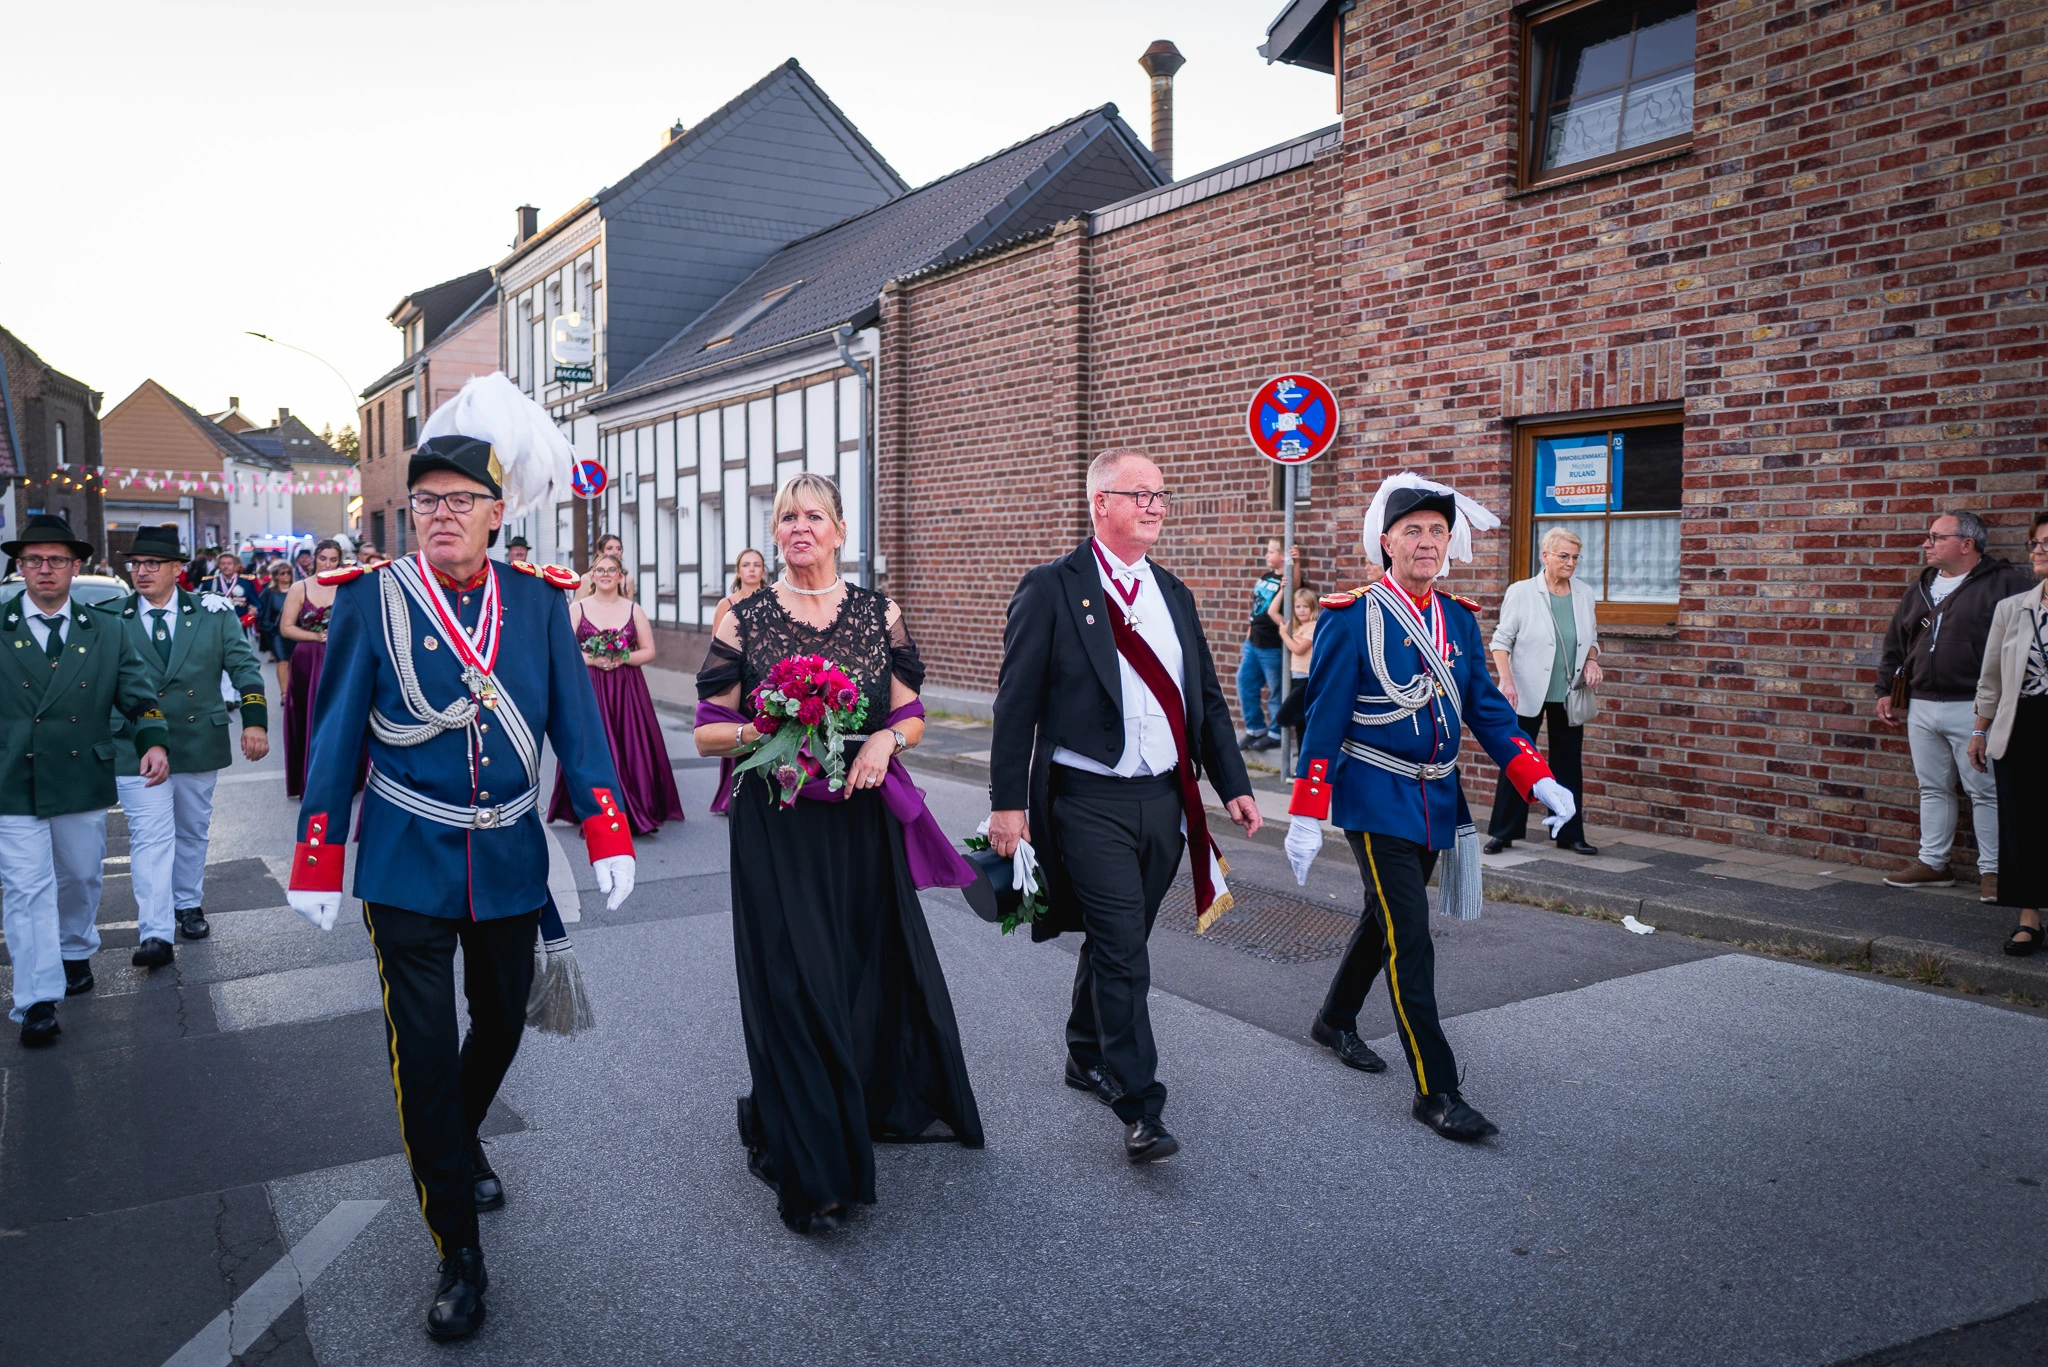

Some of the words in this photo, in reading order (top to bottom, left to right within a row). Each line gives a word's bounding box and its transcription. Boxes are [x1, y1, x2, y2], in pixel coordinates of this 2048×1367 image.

[556, 370, 591, 379] BACCARA
[1558, 453, 1607, 461] IMMOBILIENMAKLE
[1555, 486, 1575, 495] 0173
